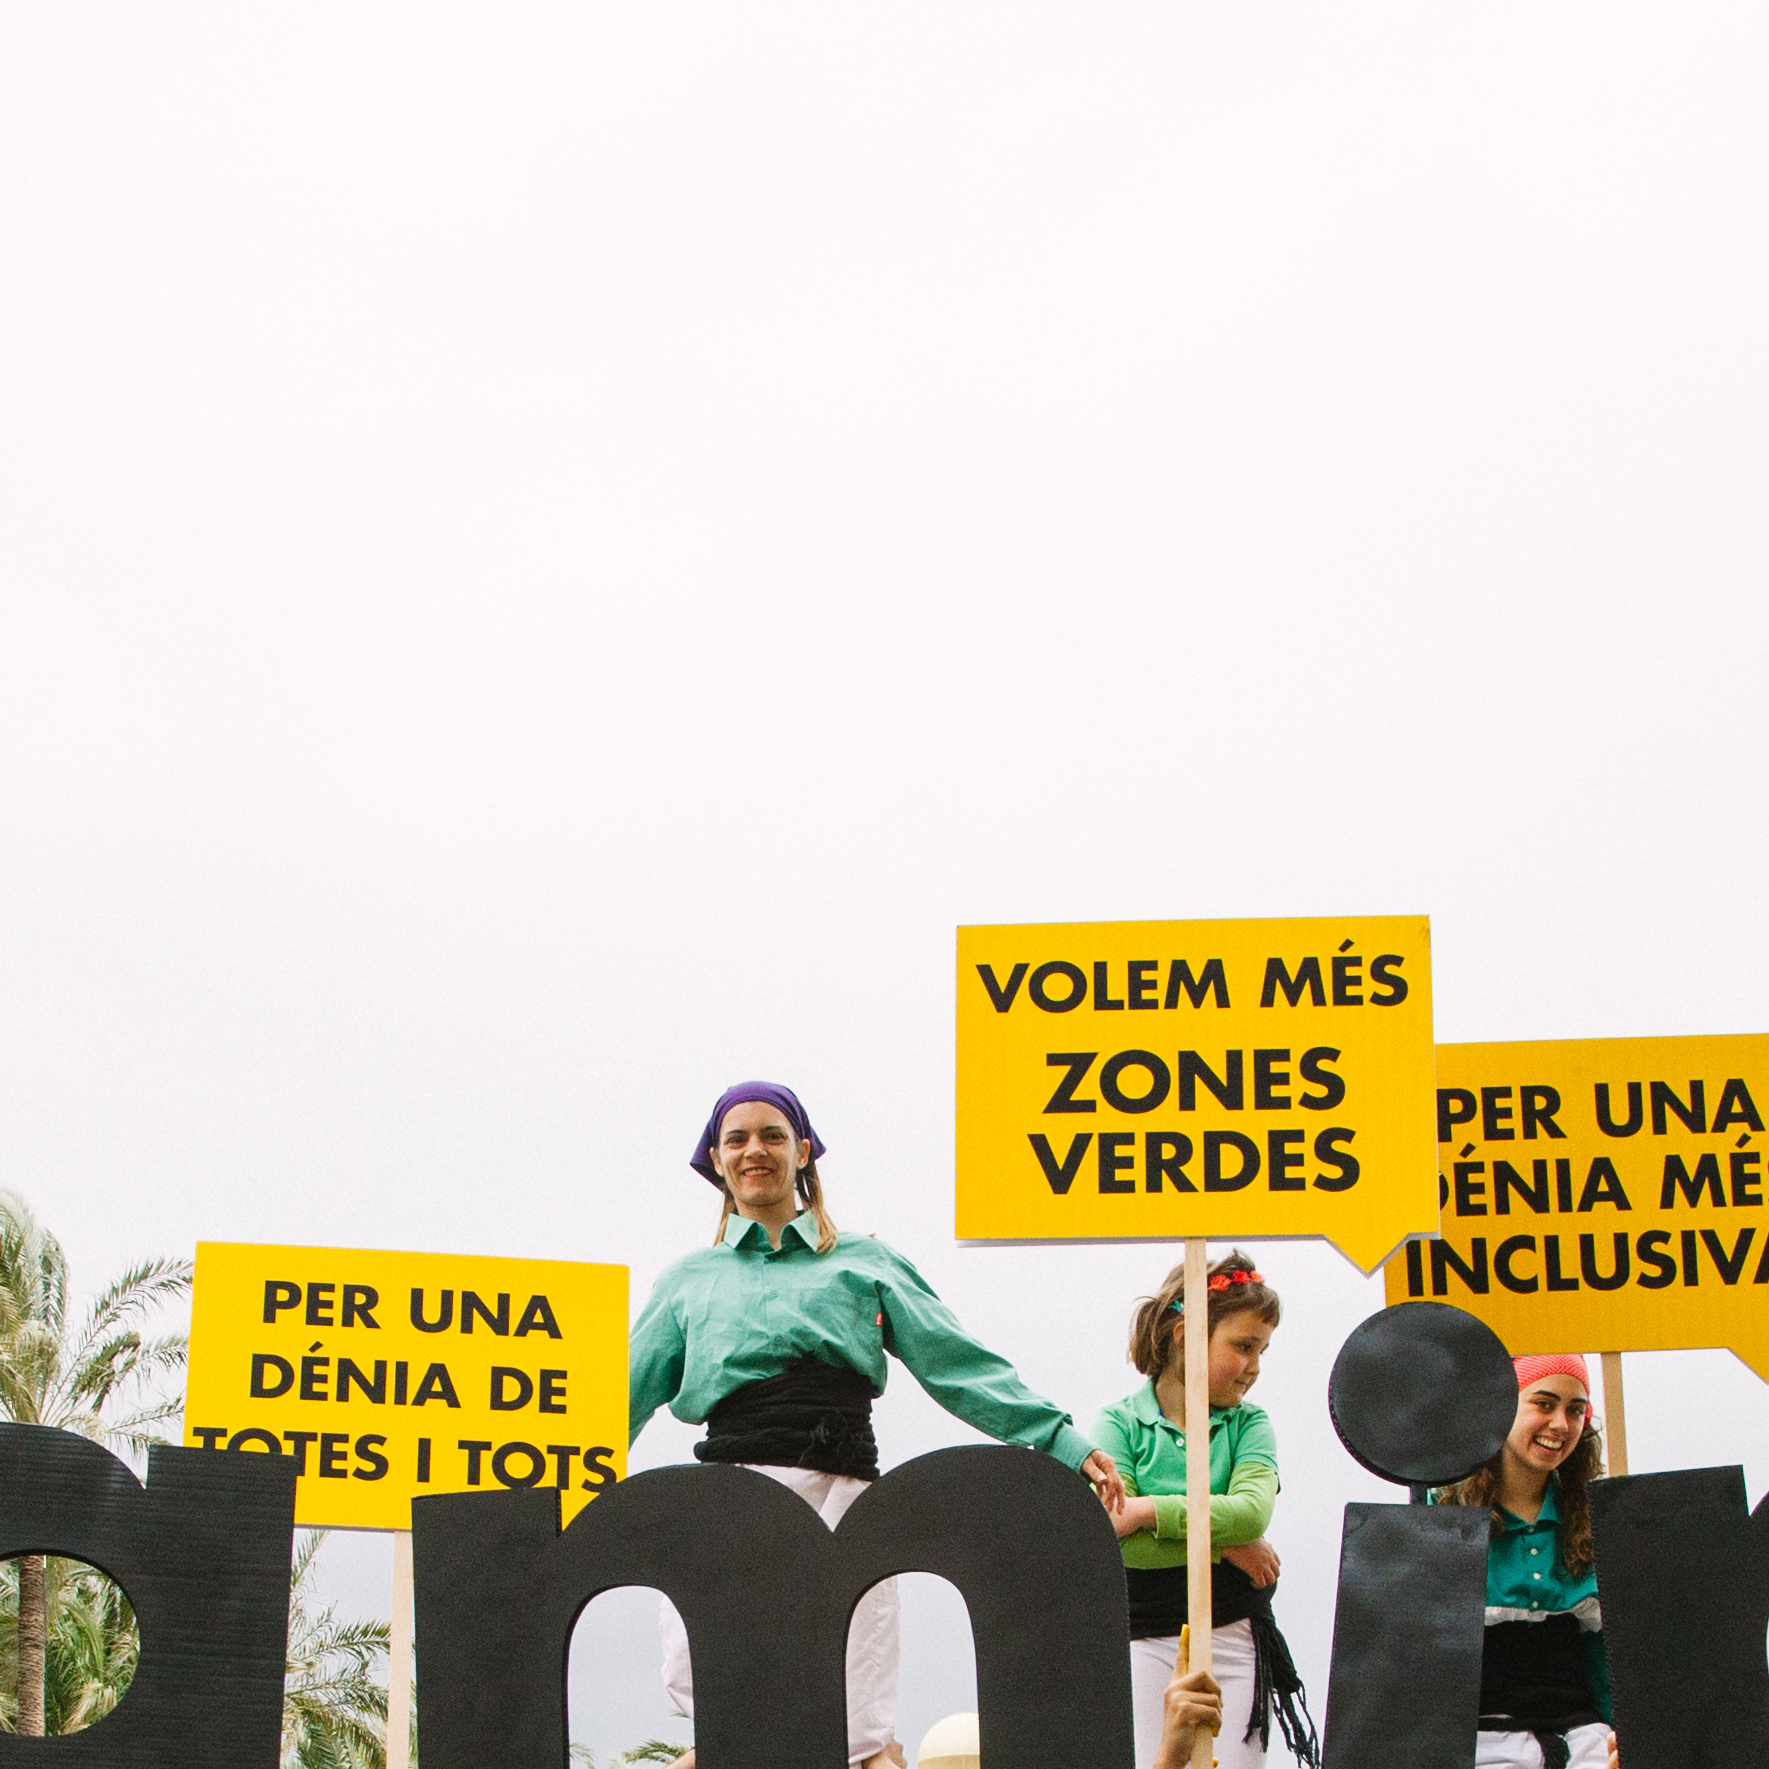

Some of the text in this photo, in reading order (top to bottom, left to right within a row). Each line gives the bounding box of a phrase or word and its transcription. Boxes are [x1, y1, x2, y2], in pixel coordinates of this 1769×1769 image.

[977, 939, 1408, 1012] VOLEM MÉS
[1043, 1047, 1345, 1113] ZONES
[1437, 1079, 1765, 1142] PER UNA
[1028, 1127, 1359, 1194] VERDES
[1439, 1143, 1632, 1216] ÉNIA
[264, 1281, 562, 1338] PER UNA
[251, 1342, 567, 1413] DÉNIA DE
[417, 1438, 432, 1483] I
[458, 1440, 617, 1492] TOTS
